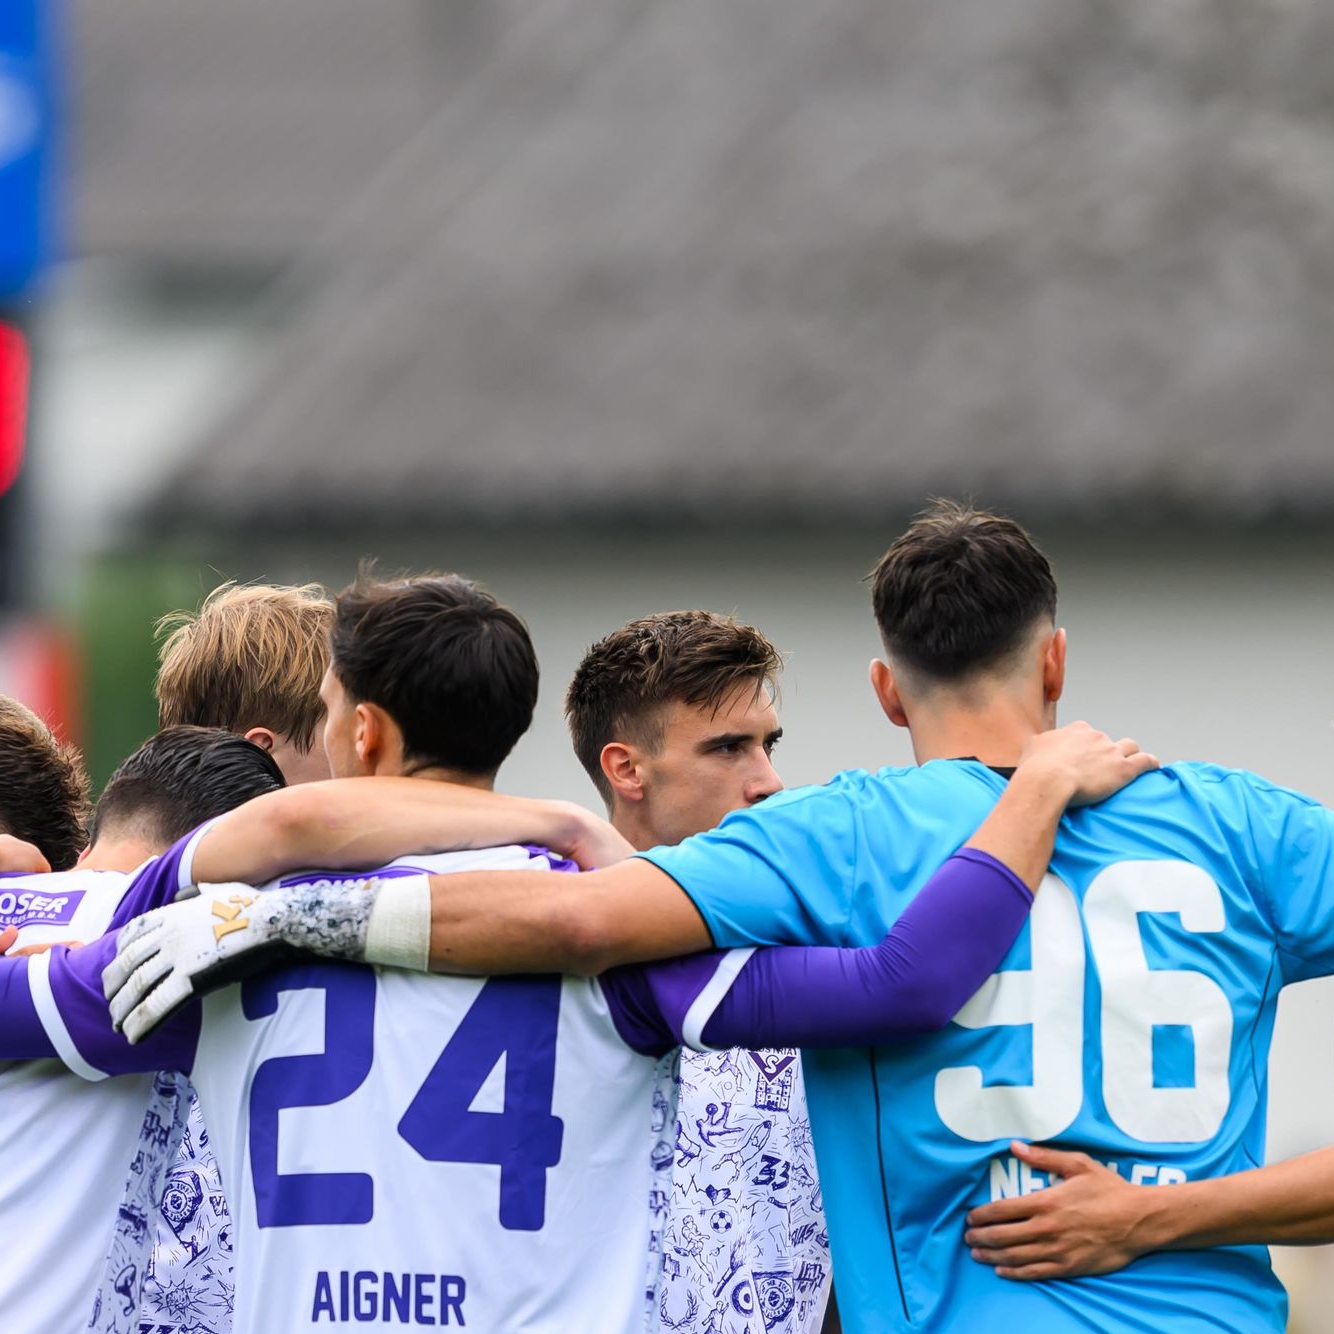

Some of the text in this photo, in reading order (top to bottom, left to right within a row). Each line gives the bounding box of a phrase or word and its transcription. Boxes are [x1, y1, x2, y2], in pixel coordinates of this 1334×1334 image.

[241, 962, 564, 1231] 24
[934, 859, 1233, 1143] 96
[311, 1271, 466, 1327] AIGNER
